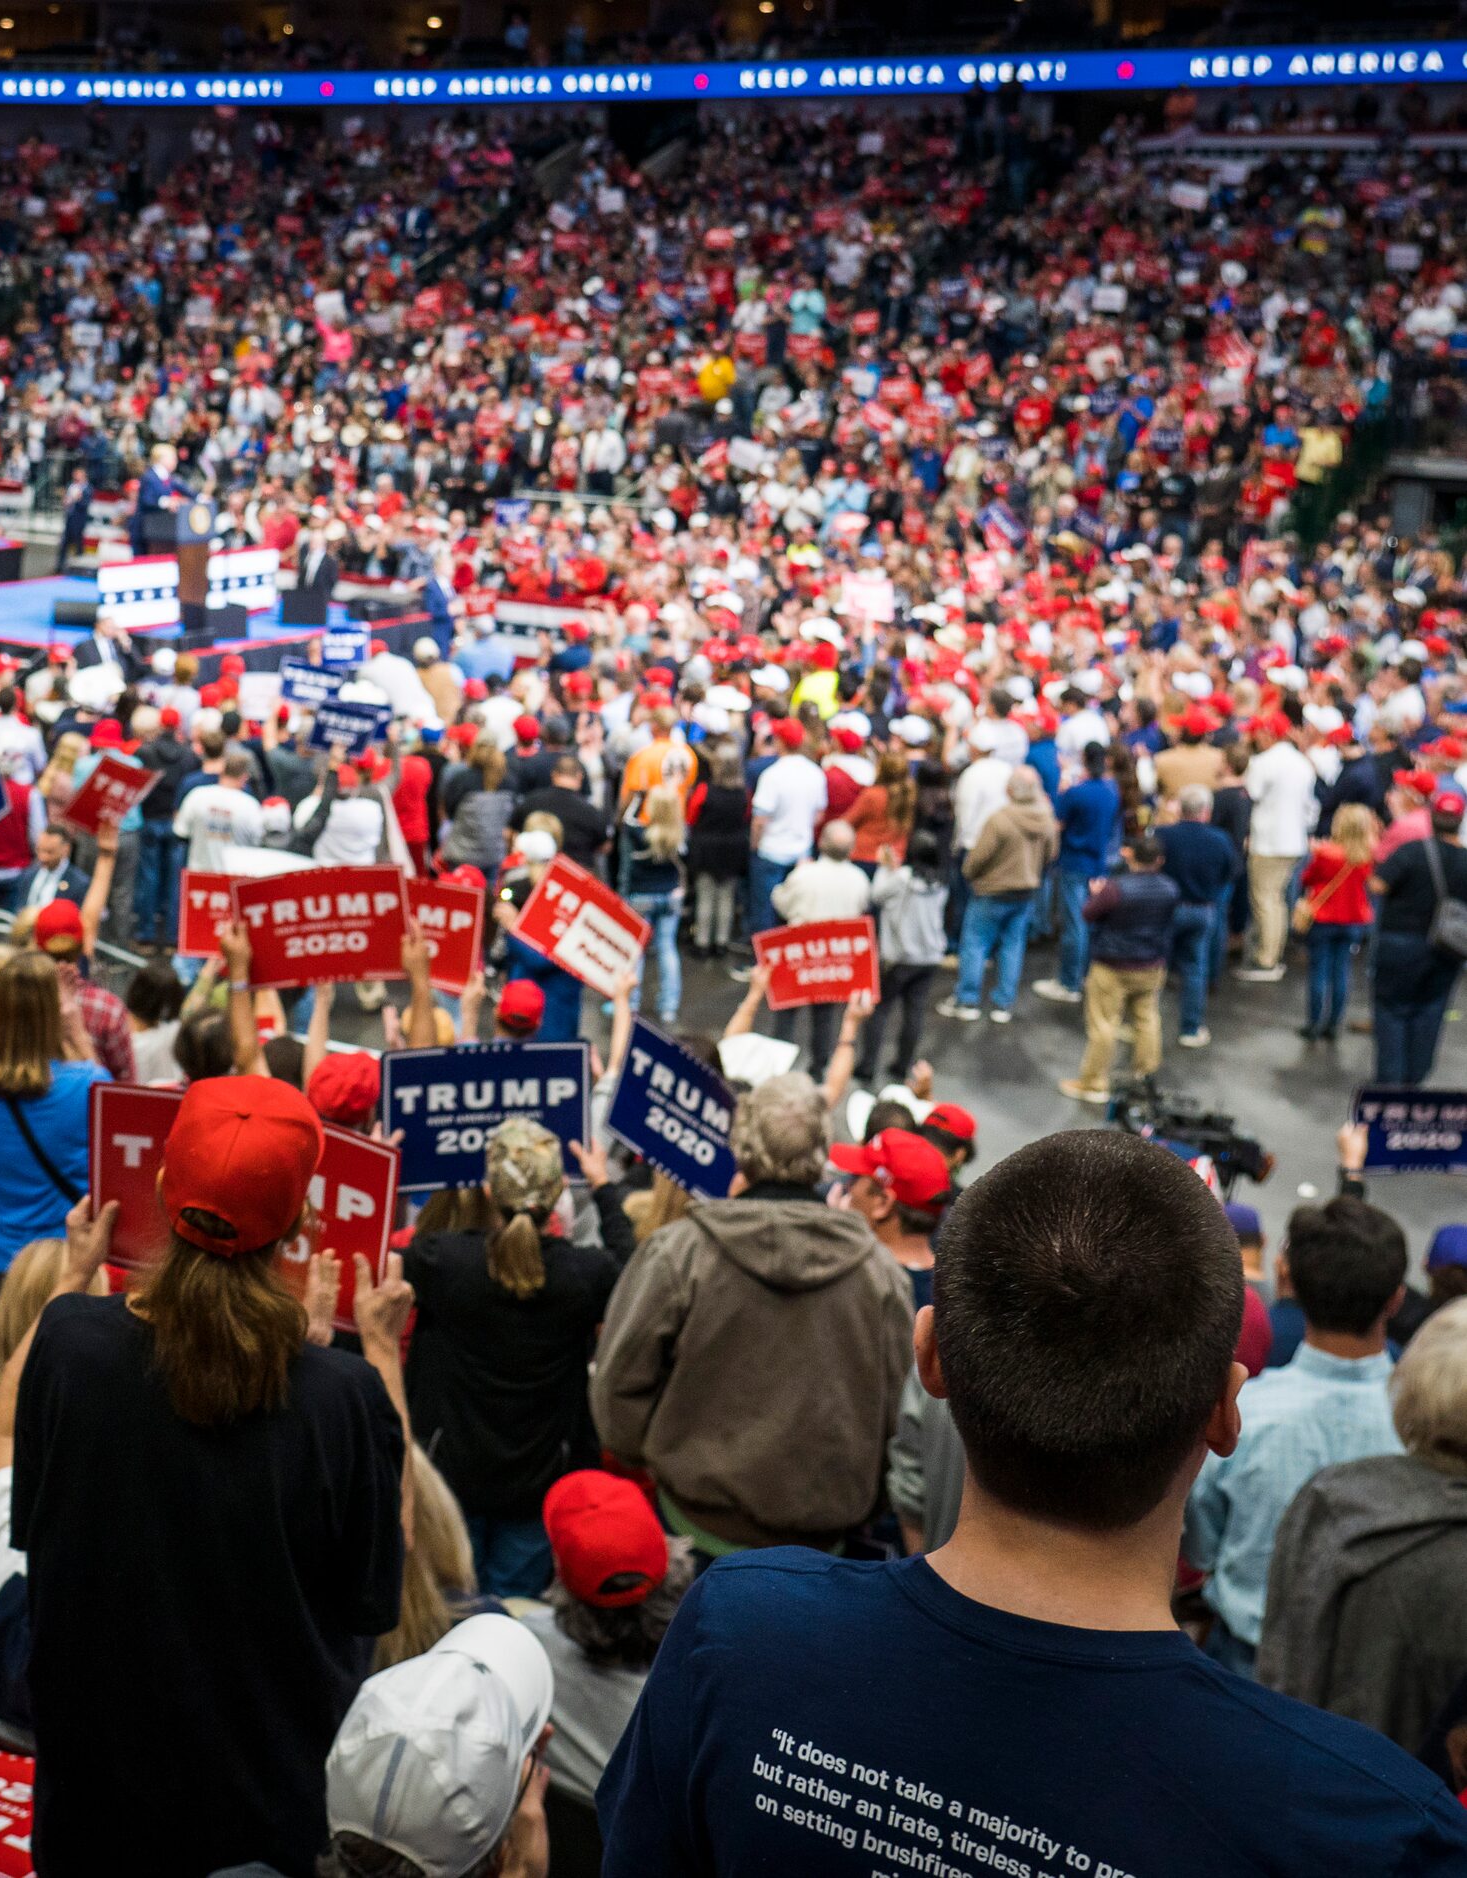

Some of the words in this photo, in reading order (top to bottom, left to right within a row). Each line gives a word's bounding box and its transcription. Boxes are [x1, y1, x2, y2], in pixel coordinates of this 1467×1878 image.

[244, 891, 399, 929] TRUMP
[285, 929, 369, 959] 2020
[765, 936, 870, 967] TRUMP
[394, 1077, 578, 1115] TRUMP
[644, 1105, 716, 1167] 2020
[752, 1754, 784, 1785] but
[786, 1772, 852, 1809] rather
[855, 1798, 882, 1822] an
[888, 1805, 944, 1849] irate,
[951, 1830, 1031, 1878] tireless
[755, 1793, 778, 1817] on
[782, 1804, 858, 1849] setting
[772, 1728, 796, 1756] “It
[798, 1741, 847, 1775] does
[851, 1763, 890, 1791] not
[895, 1776, 944, 1810] take
[948, 1800, 963, 1818] a
[968, 1806, 1061, 1861] majority
[1066, 1845, 1091, 1871] to
